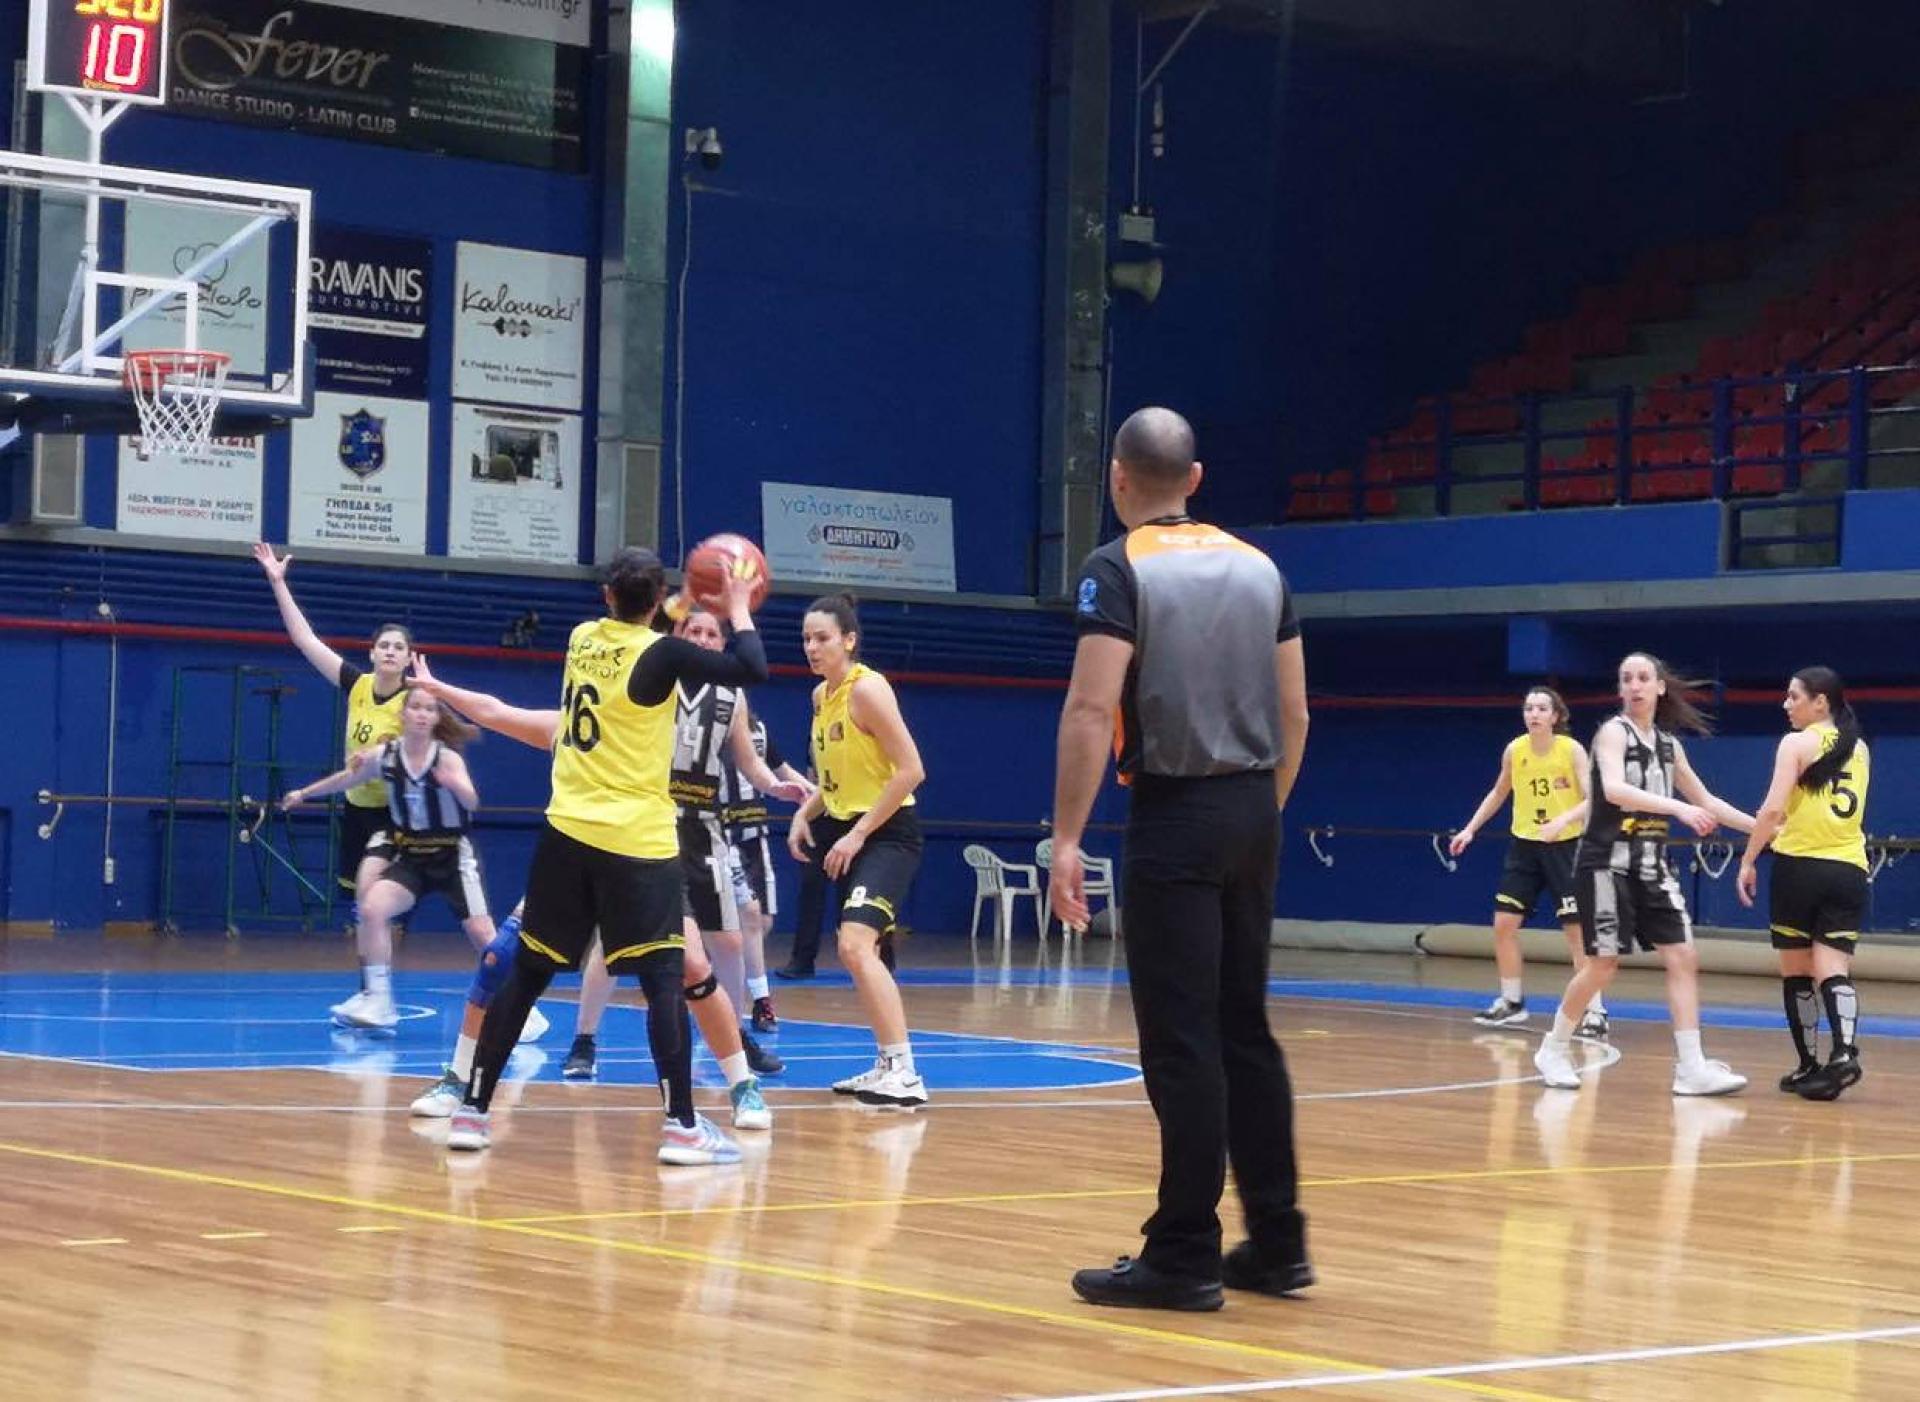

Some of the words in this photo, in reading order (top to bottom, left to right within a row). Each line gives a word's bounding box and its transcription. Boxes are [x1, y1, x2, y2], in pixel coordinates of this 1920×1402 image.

[84, 23, 146, 86] 10
[173, 86, 231, 110] DANCE
[235, 96, 295, 120] STUDIO
[308, 106, 351, 129] LATIN
[356, 113, 398, 134] CLUB
[308, 256, 424, 304] RAVANIS
[826, 530, 897, 550] ΔΗΜΗΤΡΙΟΥ
[352, 719, 373, 744] 18
[561, 668, 600, 753] 16
[1529, 778, 1551, 797] 13
[1830, 772, 1858, 819] 5
